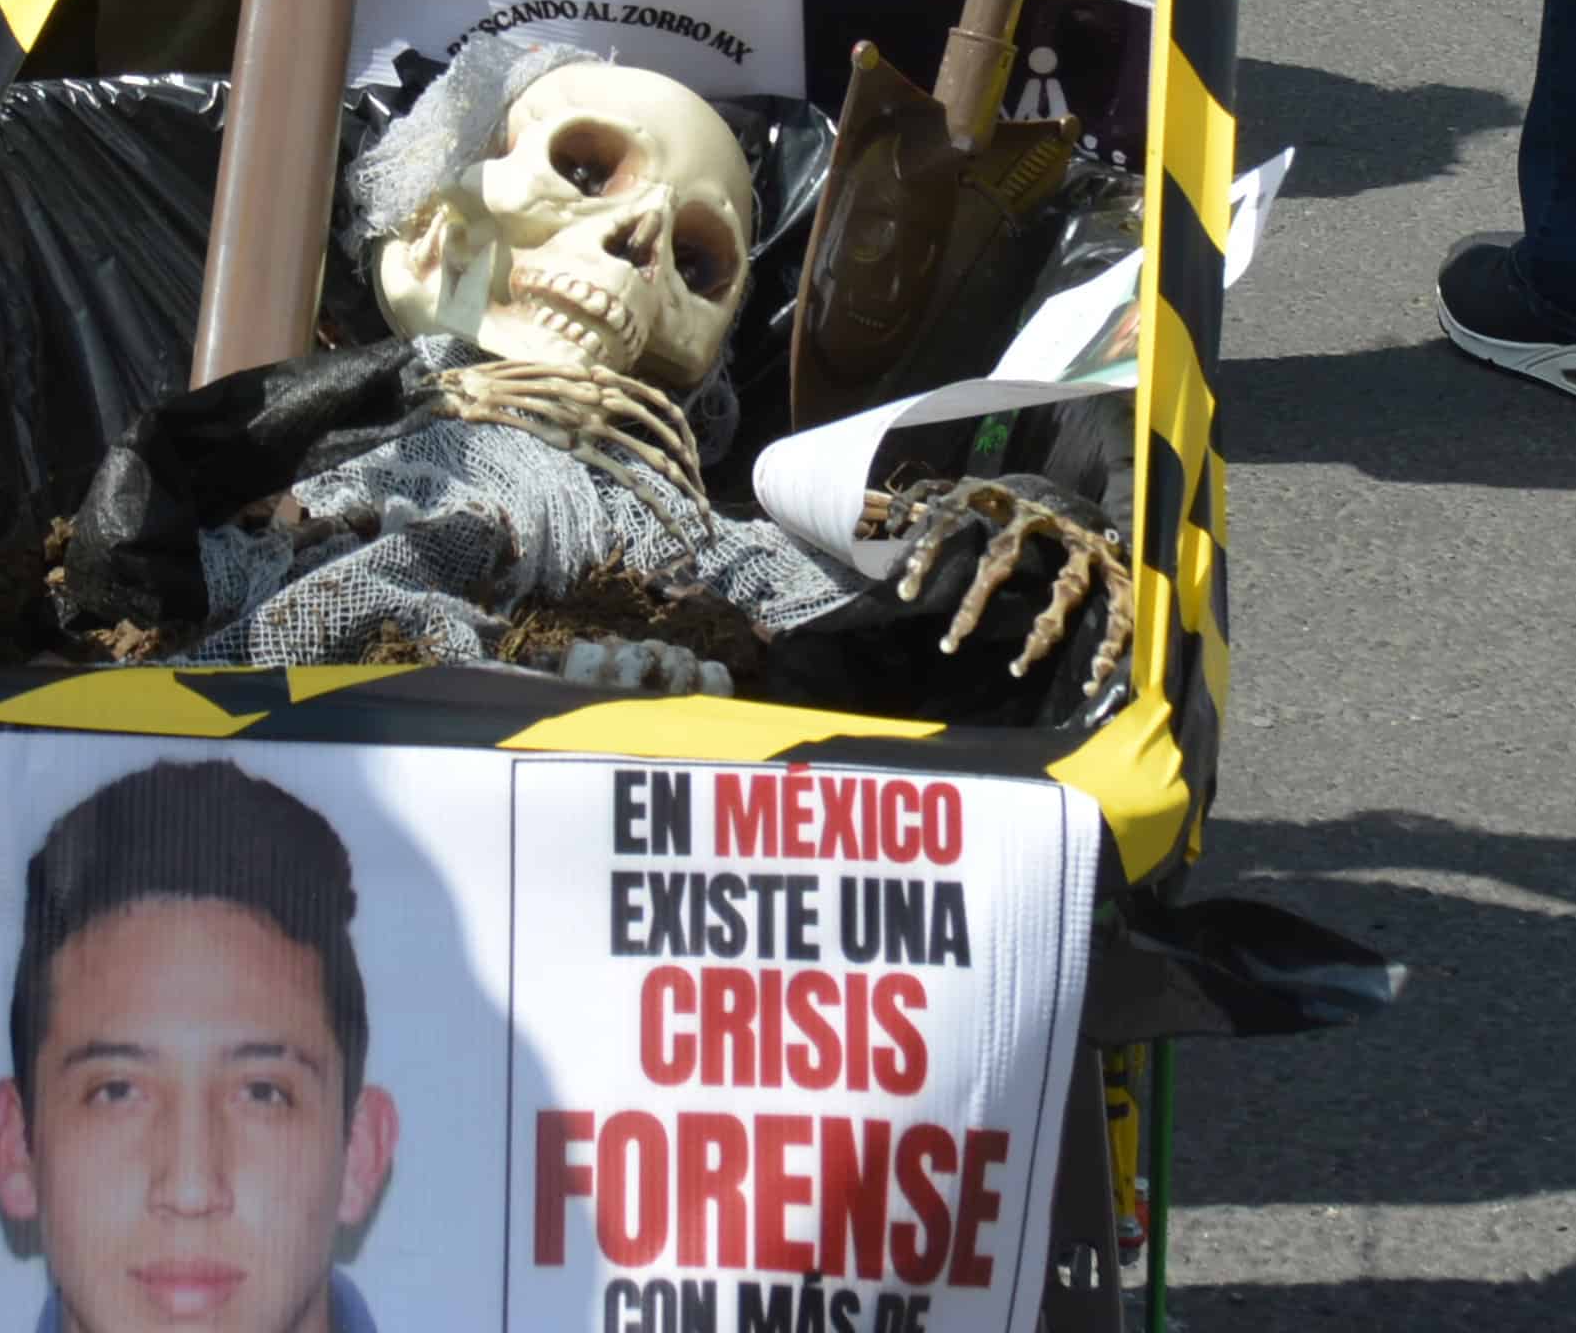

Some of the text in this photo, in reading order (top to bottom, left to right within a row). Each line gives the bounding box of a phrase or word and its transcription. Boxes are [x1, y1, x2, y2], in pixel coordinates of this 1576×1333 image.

[447, 0, 753, 65] SCANDO AL ZORRO MX
[613, 762, 963, 867] EN MÉXICO
[610, 871, 971, 968] EXISTE UNA
[640, 965, 928, 1097] CRISIS
[533, 1109, 1010, 1288] FORENSE
[604, 1279, 717, 1333] CON
[738, 1269, 860, 1333] MÁS
